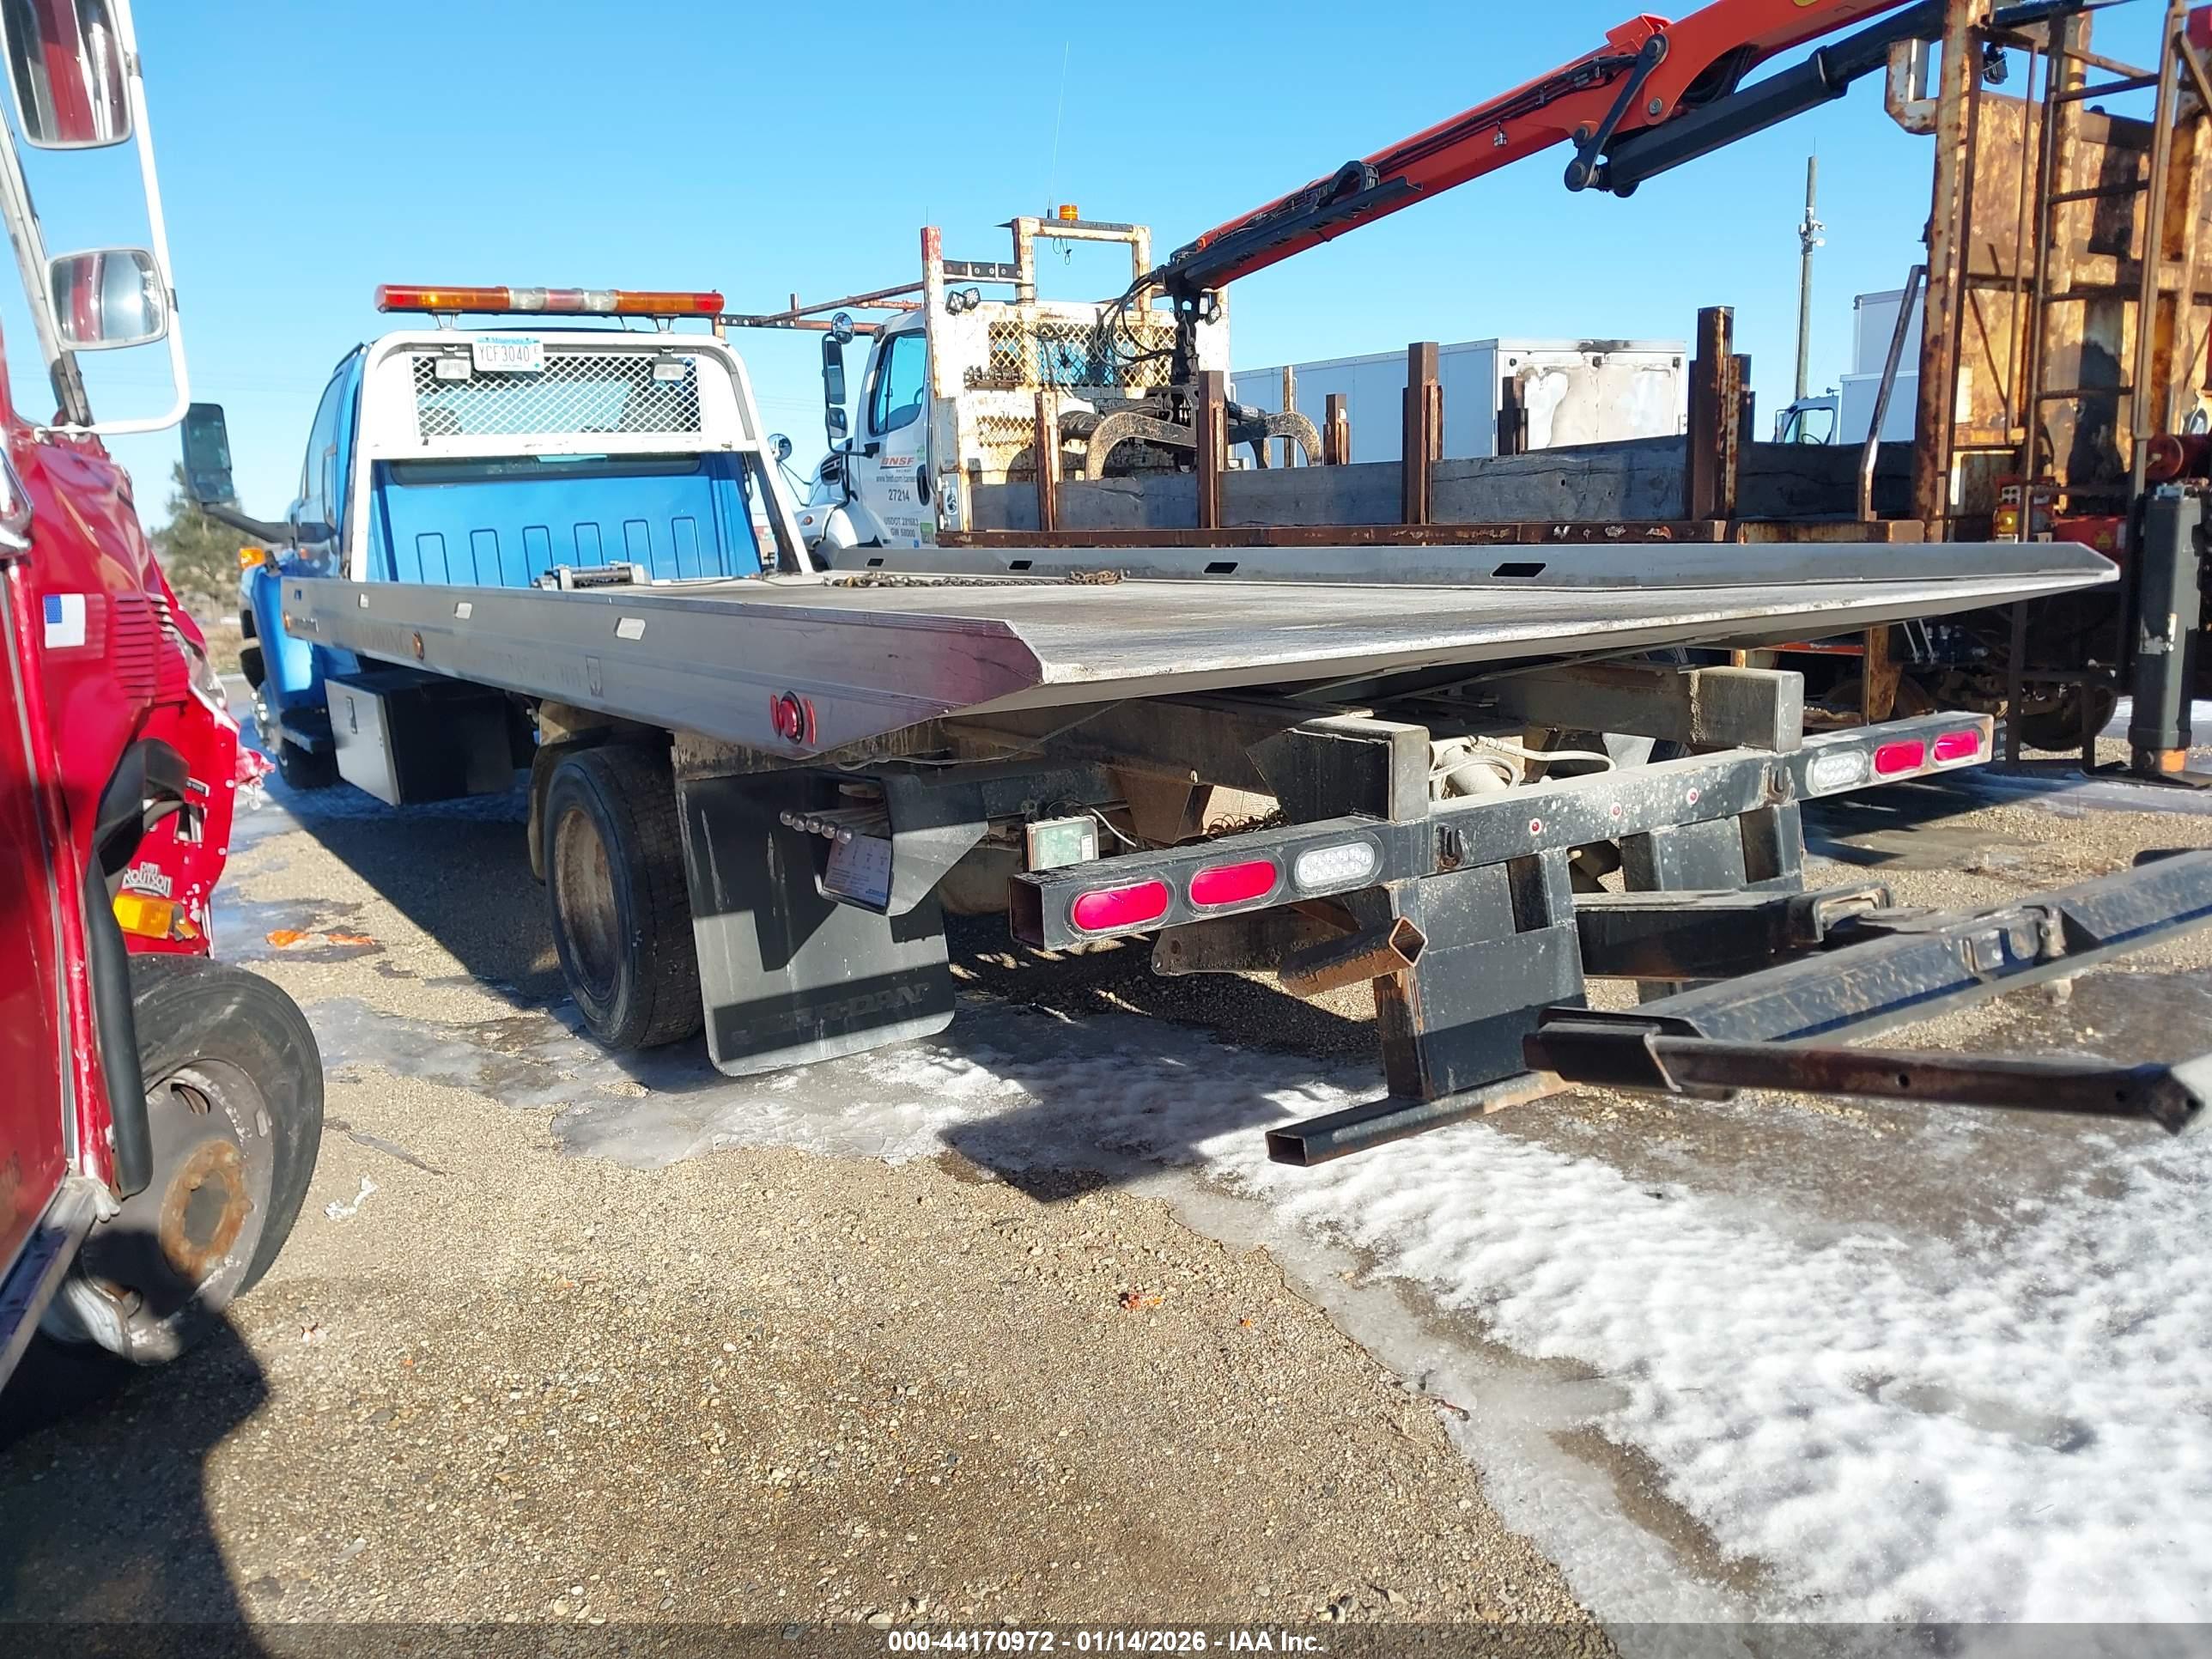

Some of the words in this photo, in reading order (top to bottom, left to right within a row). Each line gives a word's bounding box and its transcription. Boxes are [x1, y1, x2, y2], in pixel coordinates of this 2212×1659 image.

[478, 345, 531, 362] YCF3040
[881, 457, 915, 465] BNSF
[888, 488, 910, 502] 27214
